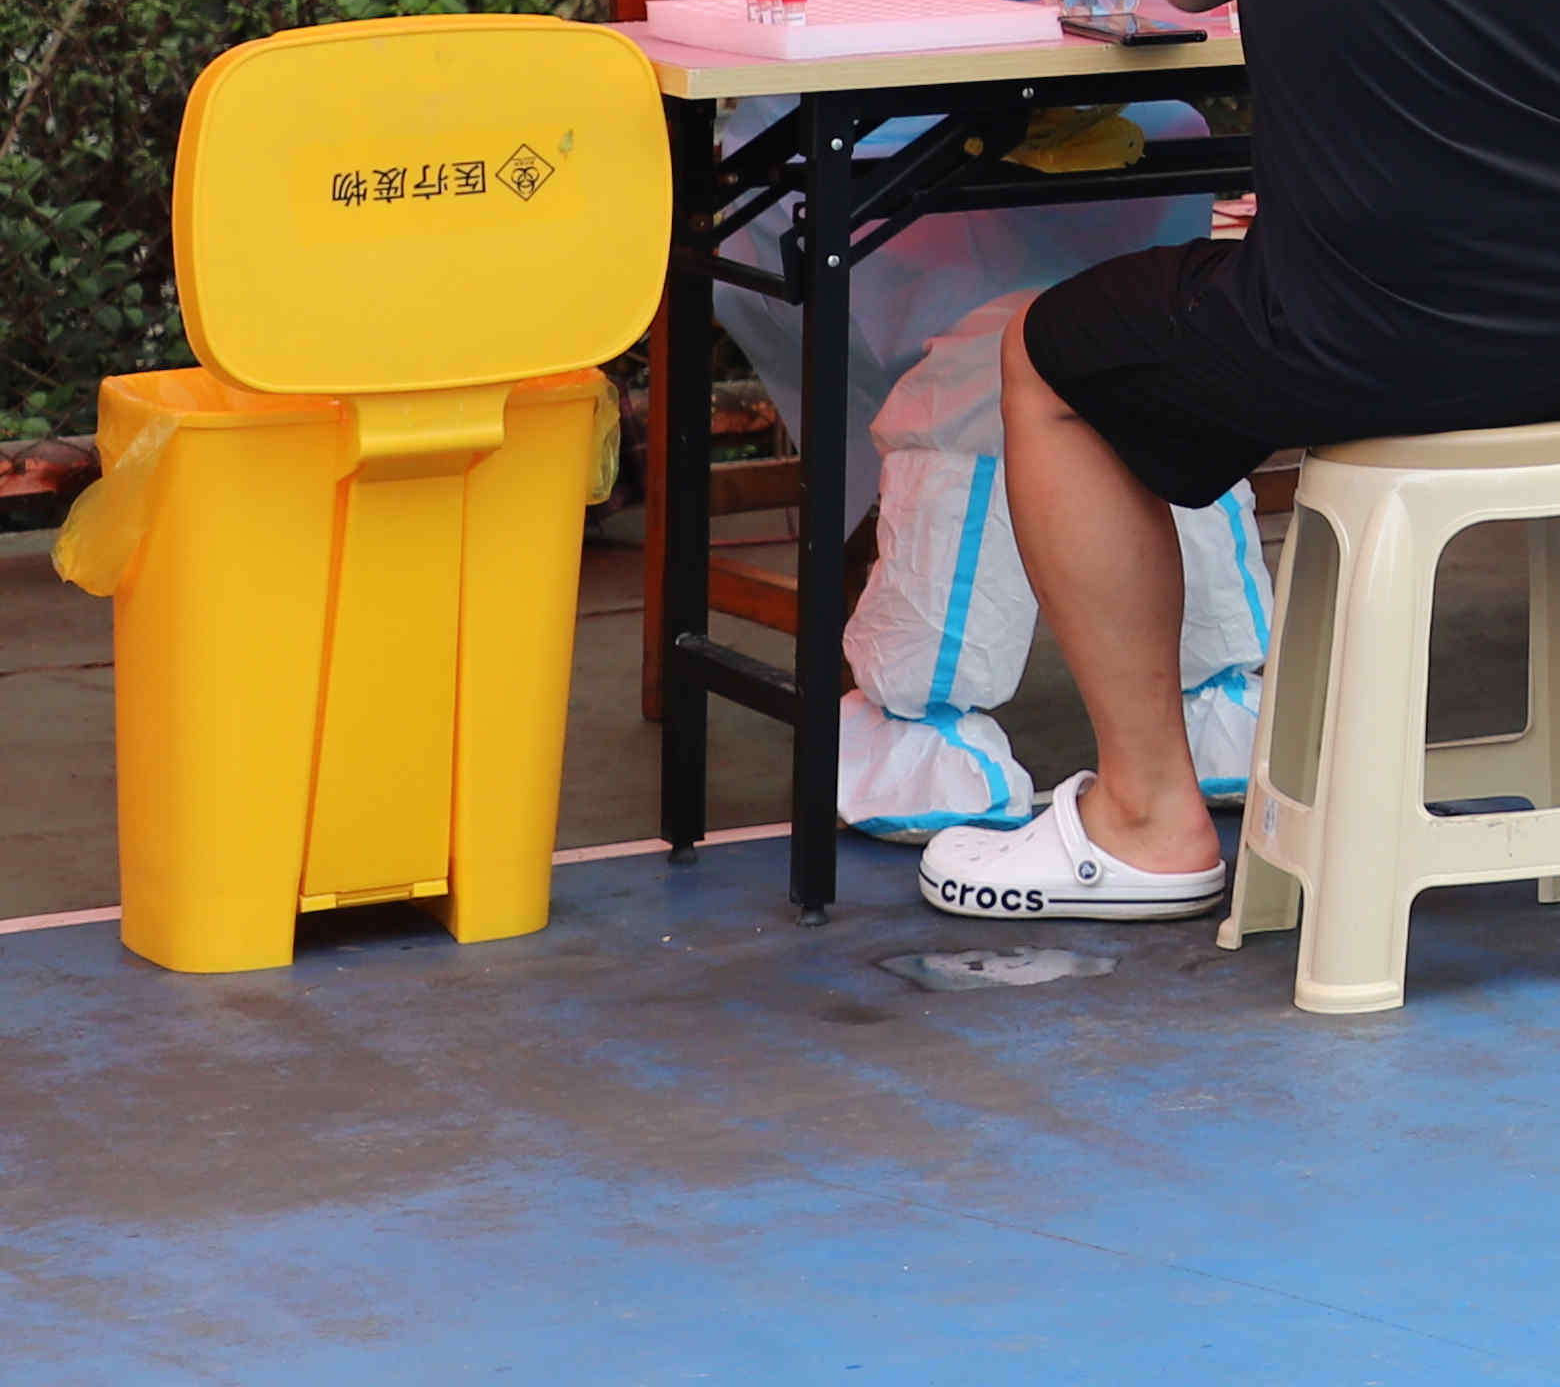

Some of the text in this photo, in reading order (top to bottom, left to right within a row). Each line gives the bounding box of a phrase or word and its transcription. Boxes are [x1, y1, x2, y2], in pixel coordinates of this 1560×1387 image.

[332, 161, 486, 208] 医疗废物
[941, 879, 1044, 912] crocs
